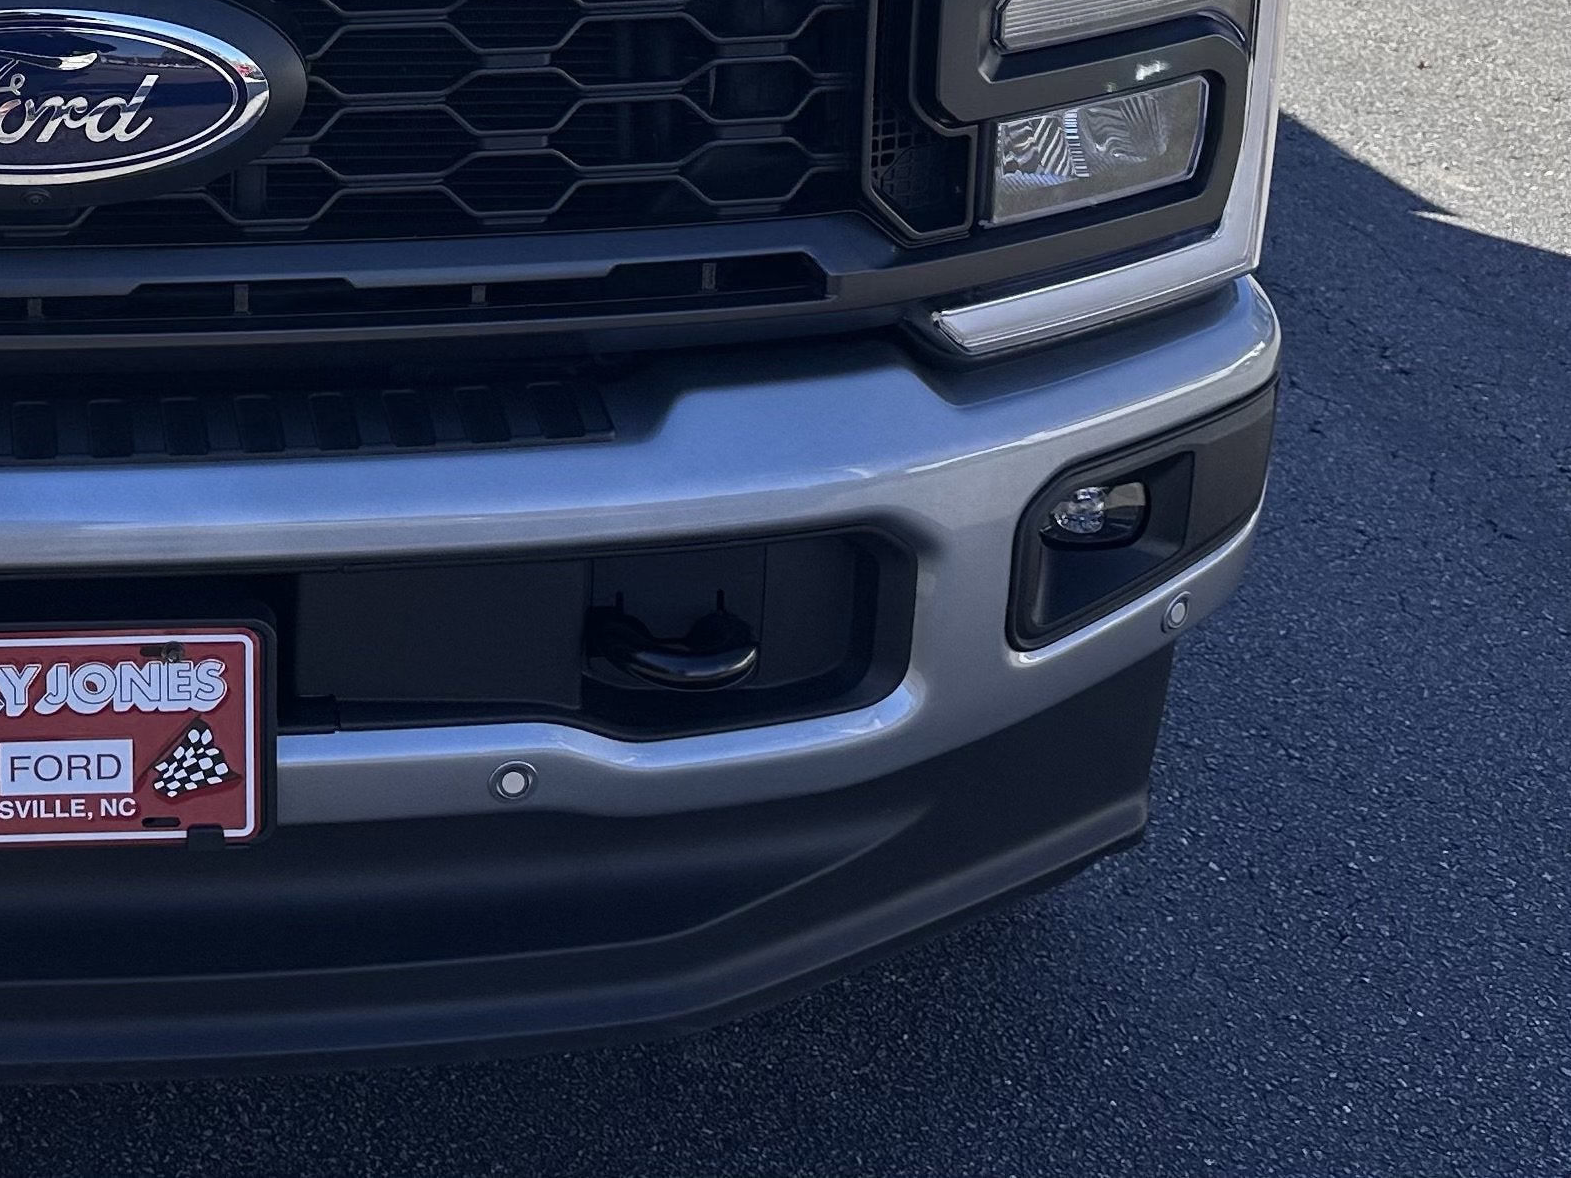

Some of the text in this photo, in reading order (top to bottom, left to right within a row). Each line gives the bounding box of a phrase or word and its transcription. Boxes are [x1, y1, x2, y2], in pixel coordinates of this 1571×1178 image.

[34, 659, 227, 715] JONES
[10, 753, 122, 782] FORD
[100, 797, 137, 817] NC
